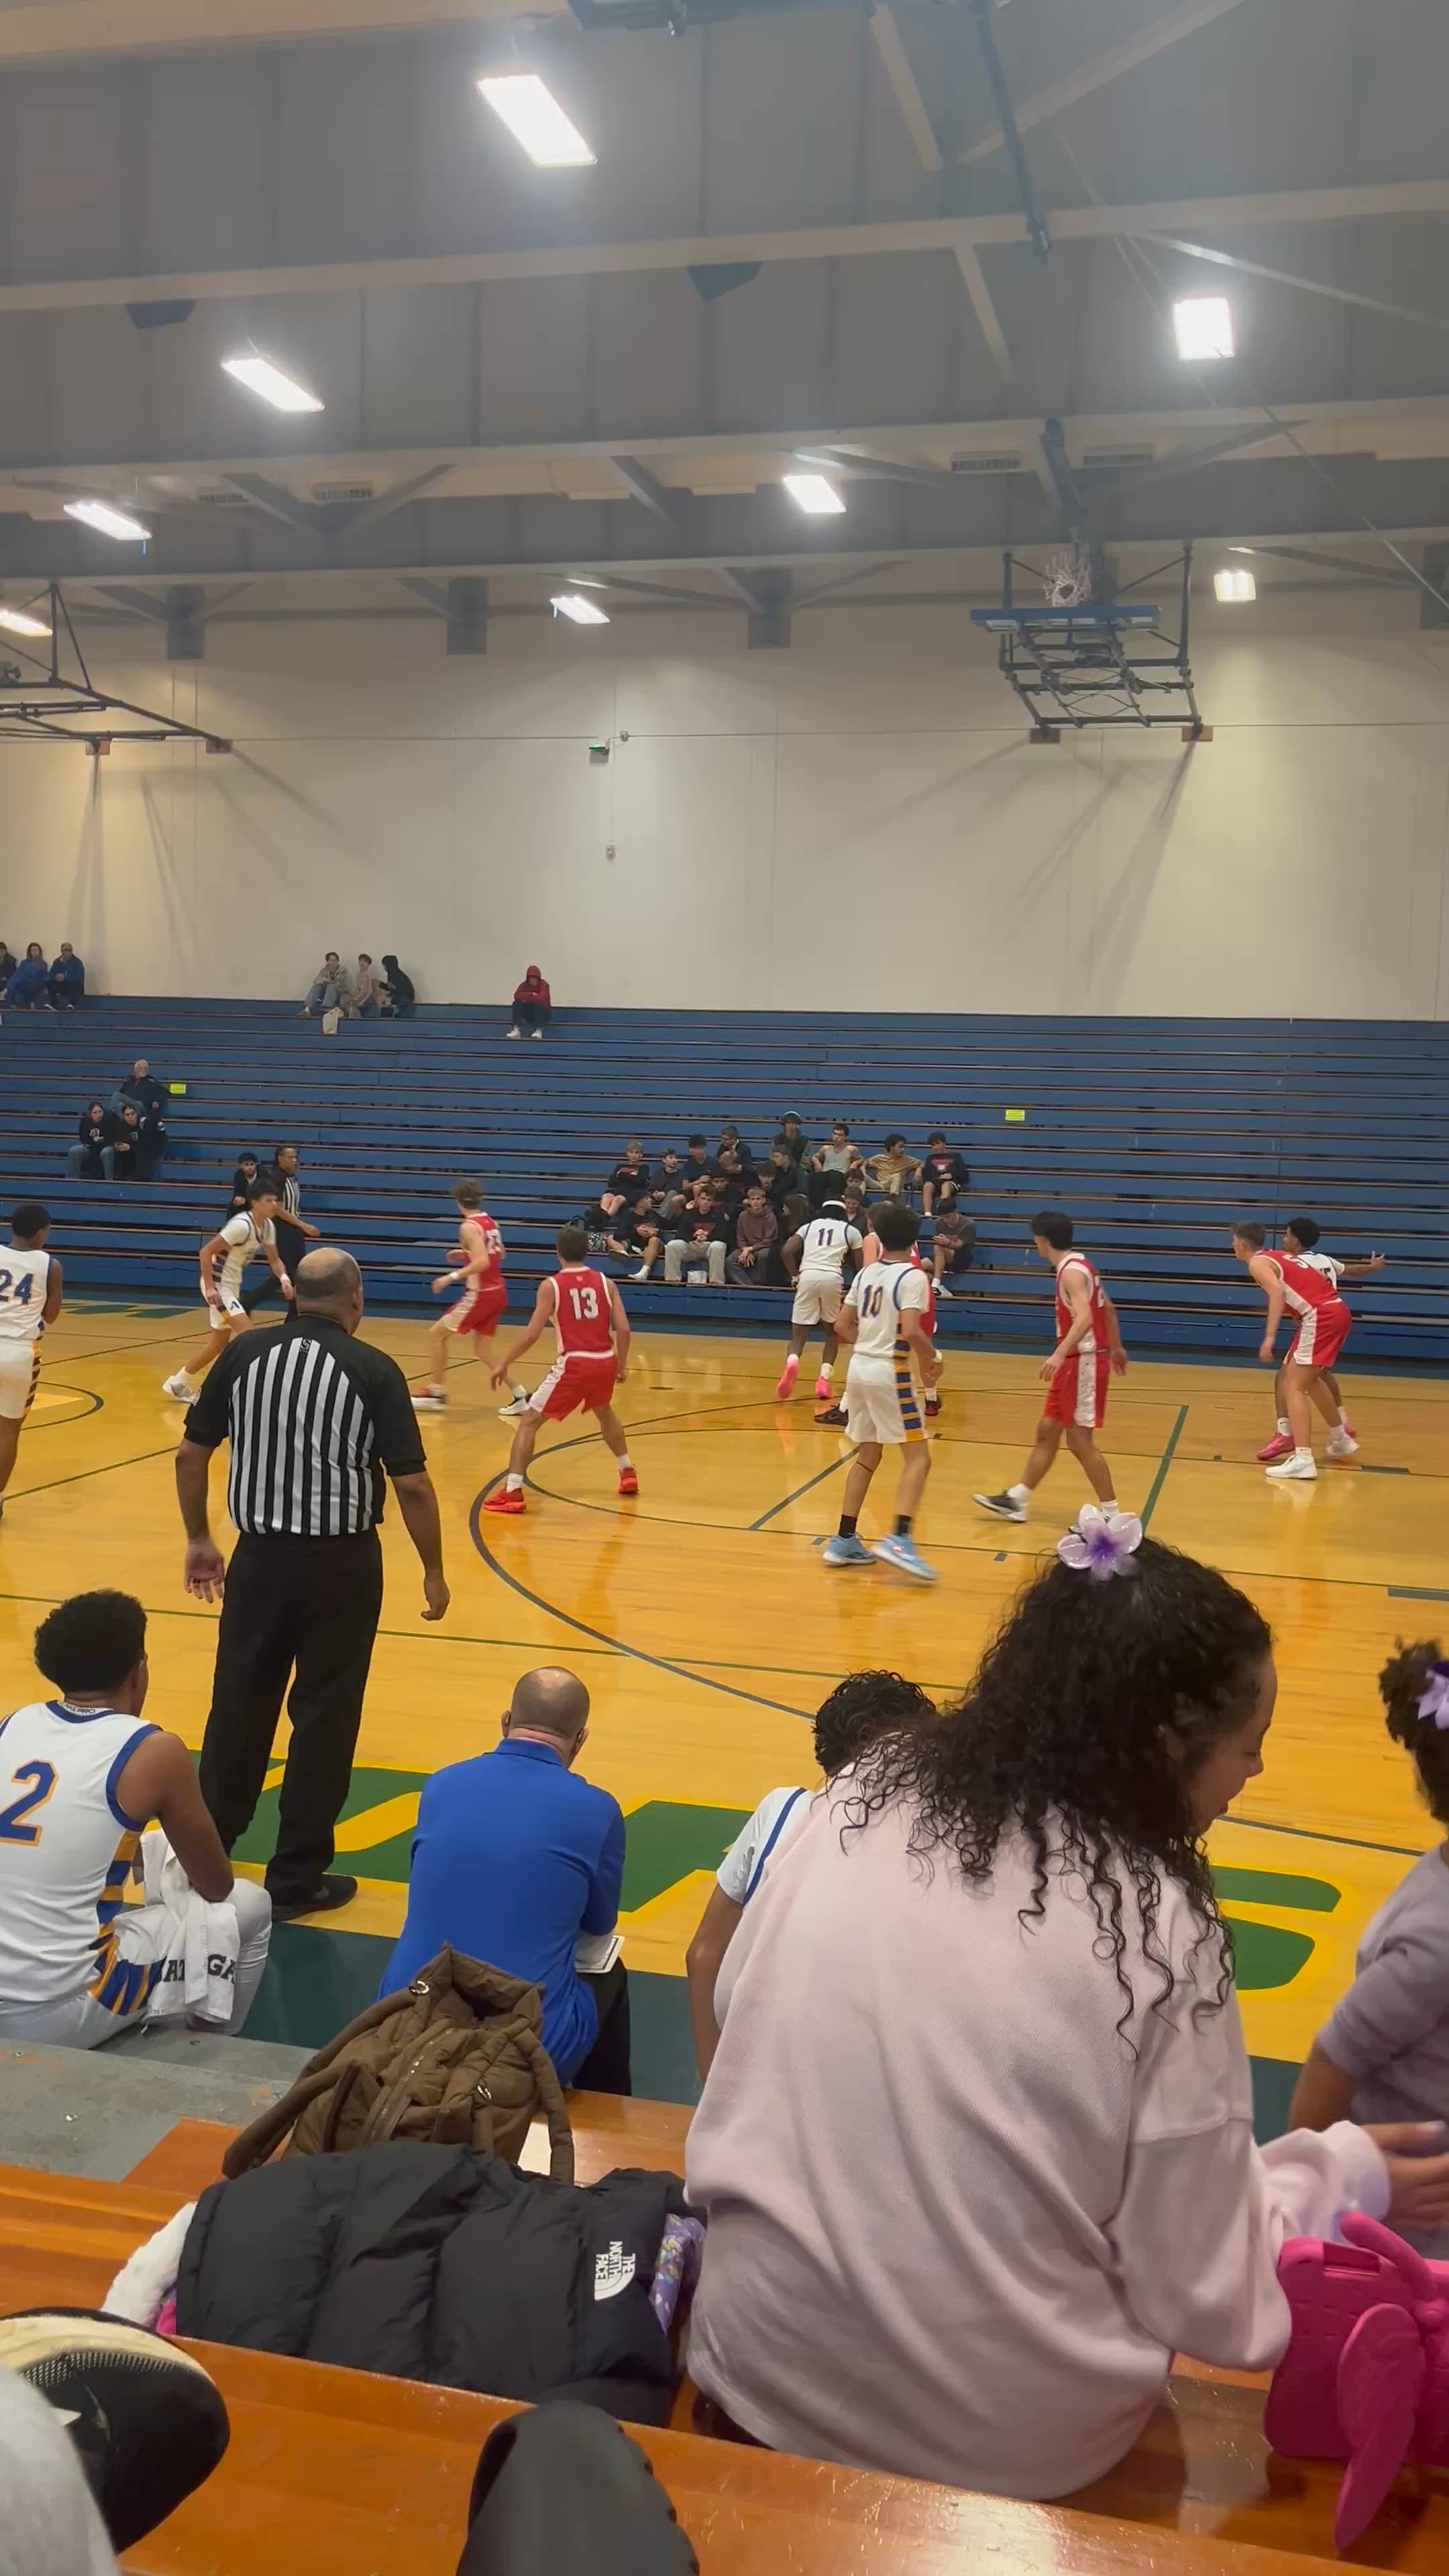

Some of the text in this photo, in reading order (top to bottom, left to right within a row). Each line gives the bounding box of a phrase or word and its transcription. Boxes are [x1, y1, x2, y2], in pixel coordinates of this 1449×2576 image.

[818, 1228, 833, 1246] 11
[0, 1269, 34, 1305] 24
[569, 1287, 598, 1320] 13
[861, 1285, 883, 1318] 10
[0, 1759, 59, 1847] 2
[595, 2253, 609, 2280] FACE
[609, 2241, 623, 2277] NORTH
[621, 2253, 636, 2275] THE
